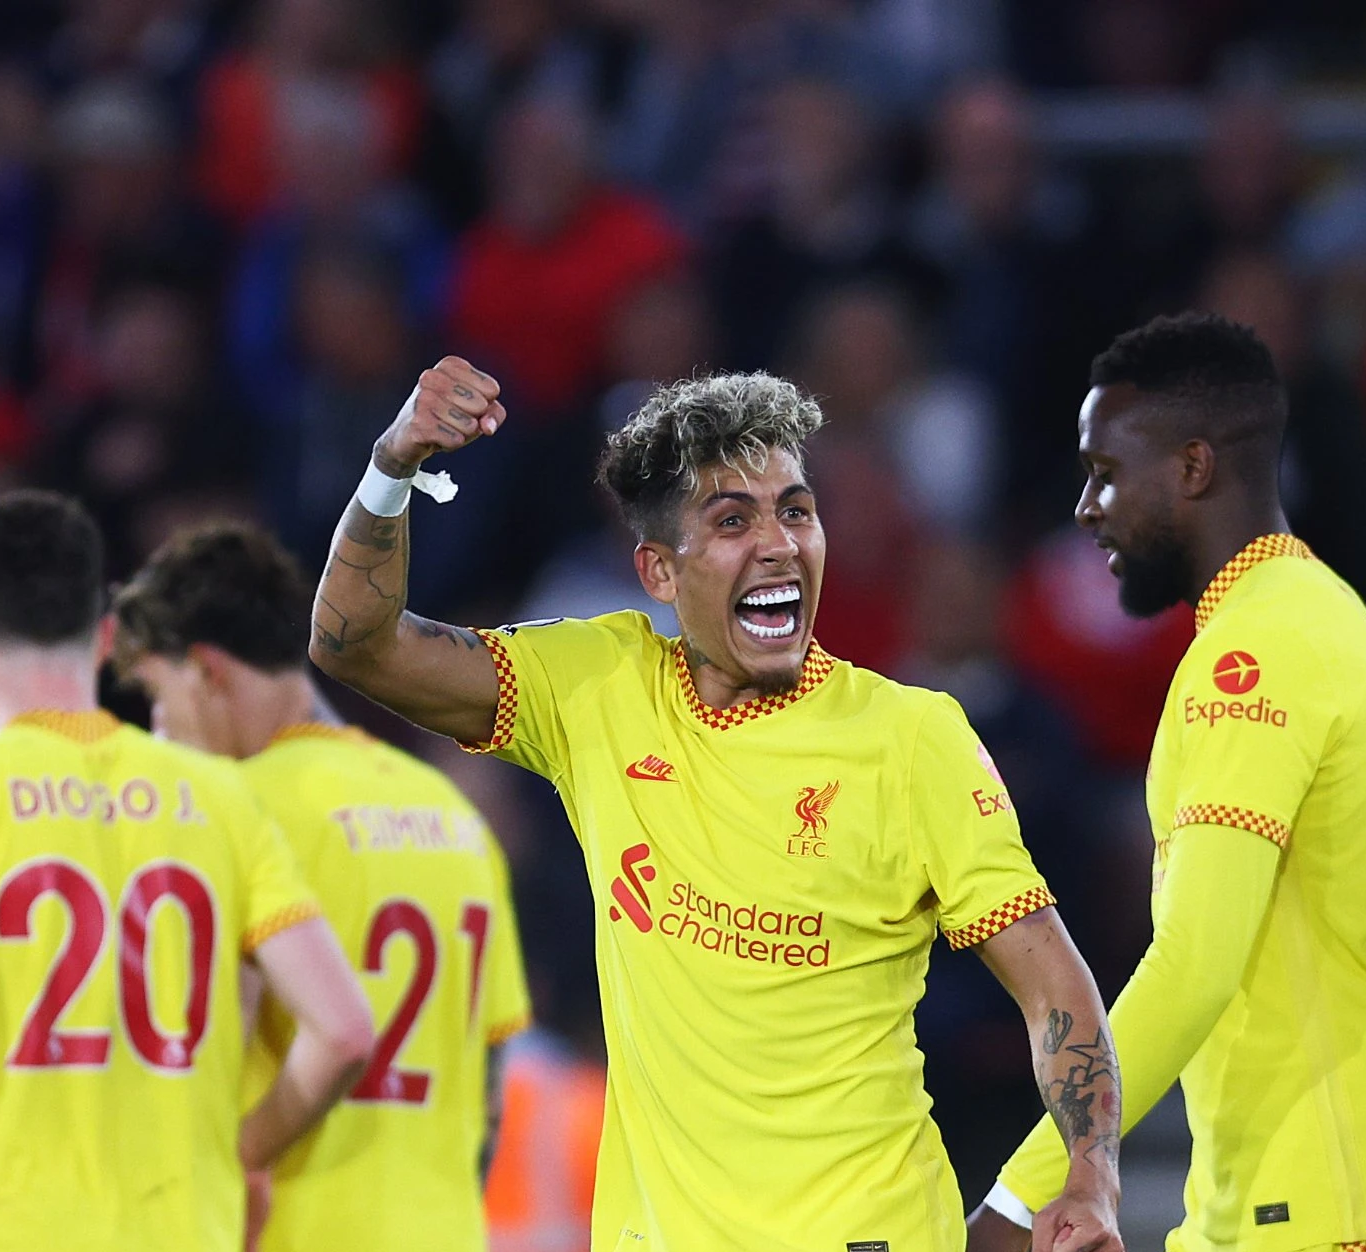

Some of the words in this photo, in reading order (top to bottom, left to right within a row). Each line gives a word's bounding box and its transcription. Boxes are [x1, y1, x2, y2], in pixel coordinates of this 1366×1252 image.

[1185, 696, 1287, 728] Expedia
[668, 882, 823, 936] standard
[659, 913, 831, 967] chartered
[344, 896, 493, 1106] 21
